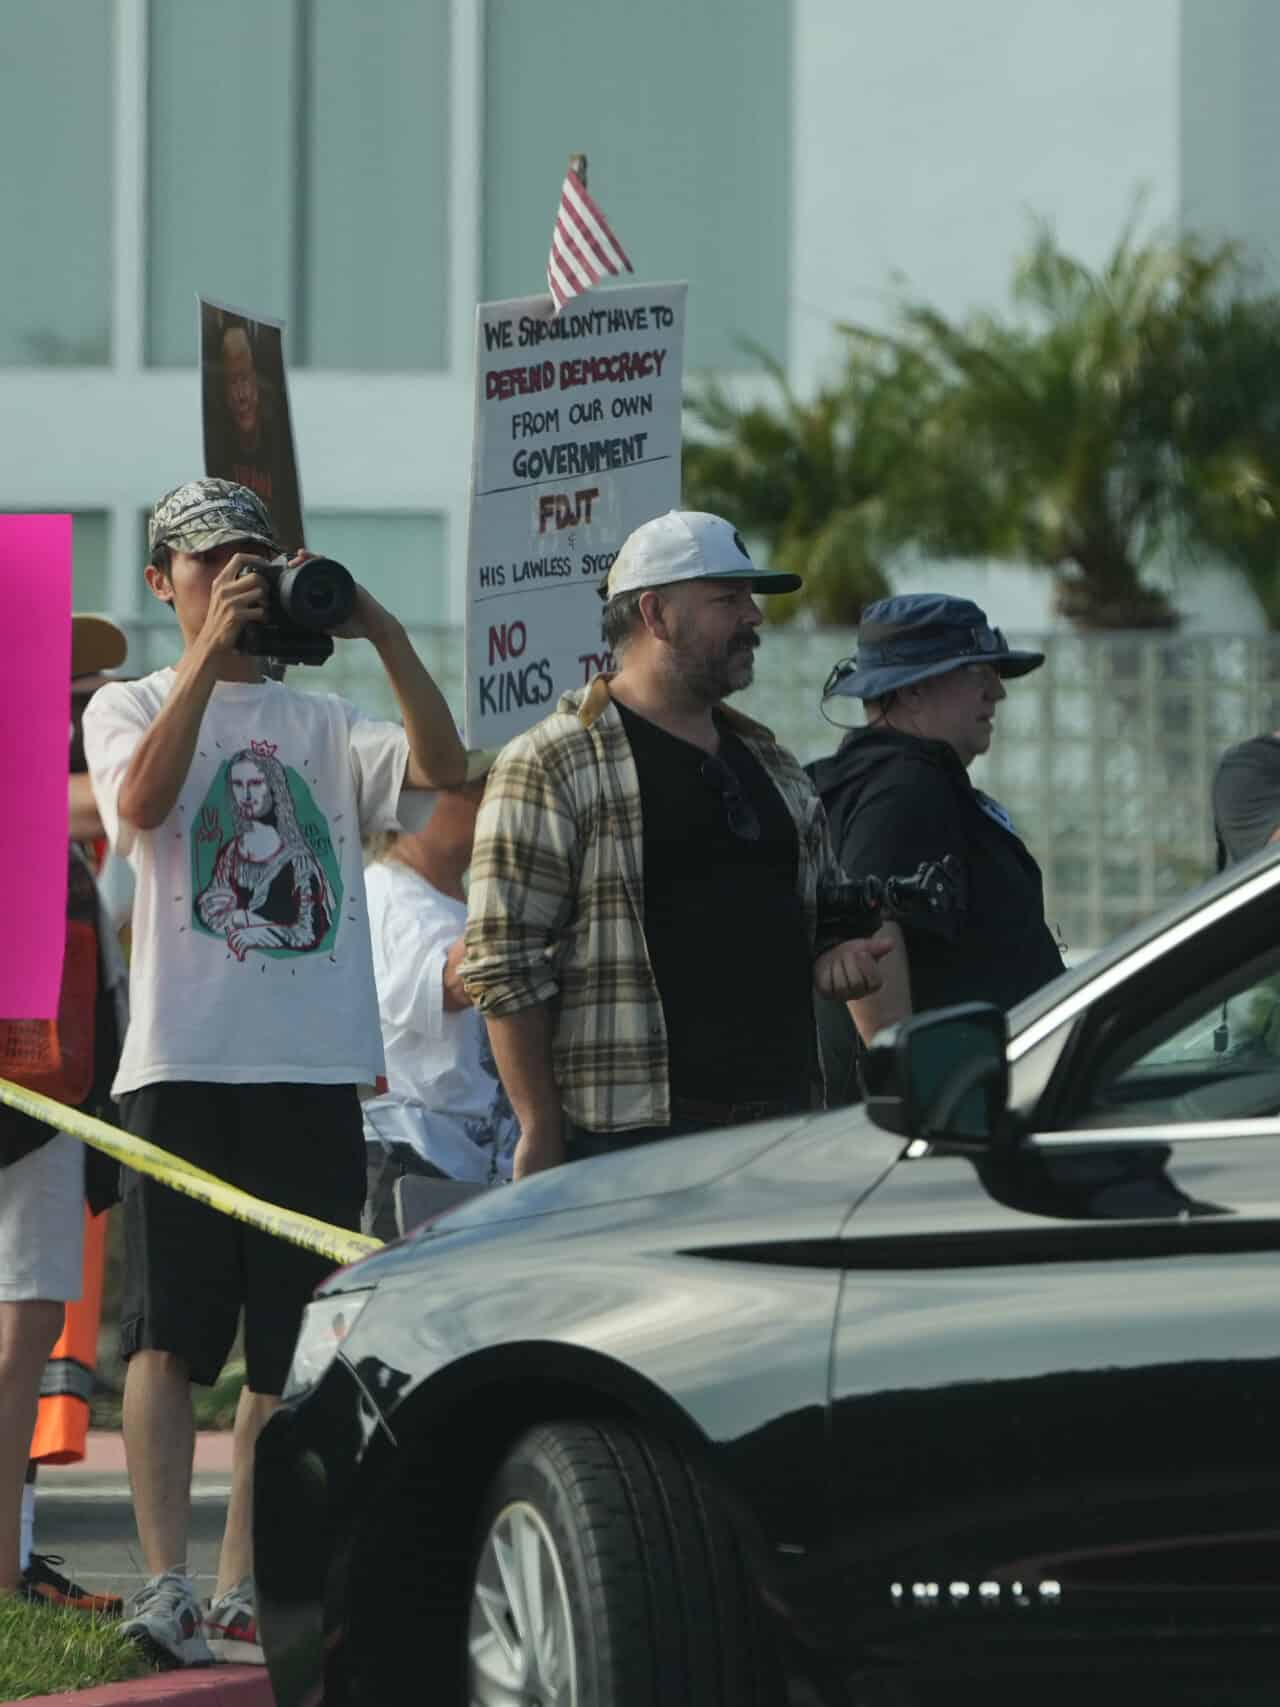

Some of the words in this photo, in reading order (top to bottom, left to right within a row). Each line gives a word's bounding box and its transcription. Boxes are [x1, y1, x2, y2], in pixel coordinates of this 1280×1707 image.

[484, 317, 513, 351] WE
[606, 306, 648, 333] HAVE
[650, 305, 674, 328] TO
[485, 361, 555, 400] DEFEND
[559, 349, 667, 391] DEMOCRACY
[511, 408, 560, 440] FROM
[568, 399, 604, 425] OUR
[611, 393, 653, 419] OWN
[512, 432, 648, 479] GOVERNMENT
[539, 488, 600, 534] FDJT
[480, 565, 506, 588] HIS
[512, 556, 572, 583] LAWLESS
[581, 550, 620, 576] SYCO
[488, 620, 527, 666] NO
[479, 658, 553, 717] KINGS
